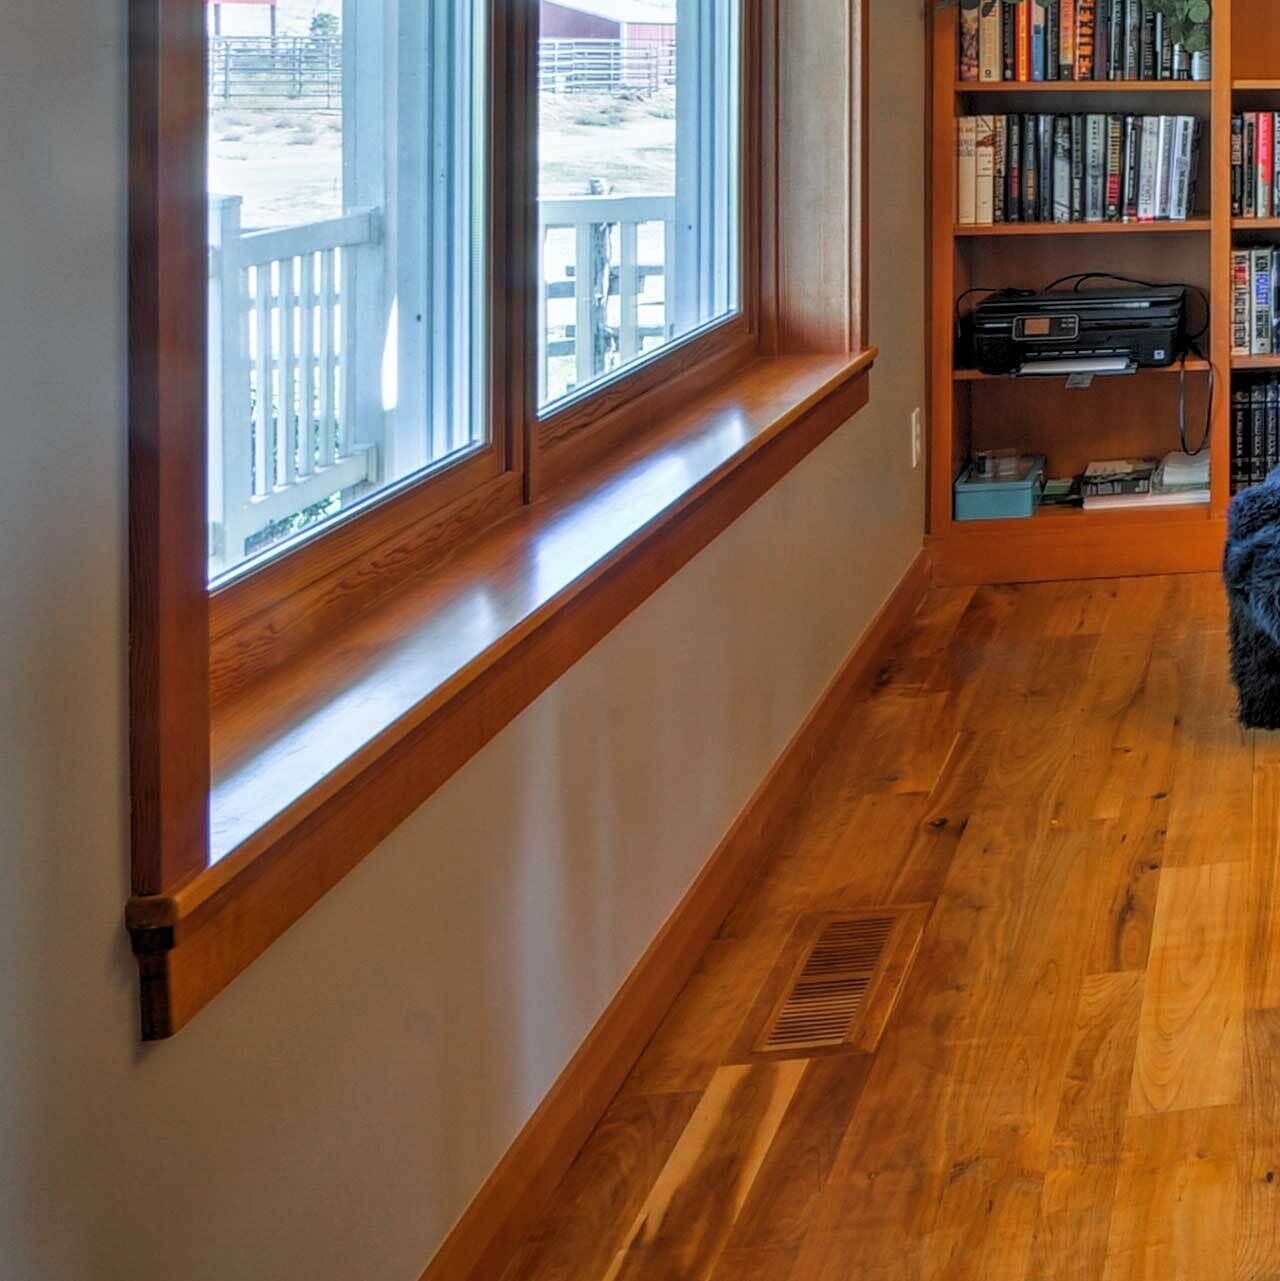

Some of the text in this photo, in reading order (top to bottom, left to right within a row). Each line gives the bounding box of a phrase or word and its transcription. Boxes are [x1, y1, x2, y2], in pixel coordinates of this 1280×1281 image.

[1078, 7, 1095, 66] EXILE
[1255, 256, 1269, 305] KEN FOLLETT
[1236, 411, 1245, 456] WORLD BOOK
[1253, 410, 1262, 456] WORLD BOOK
